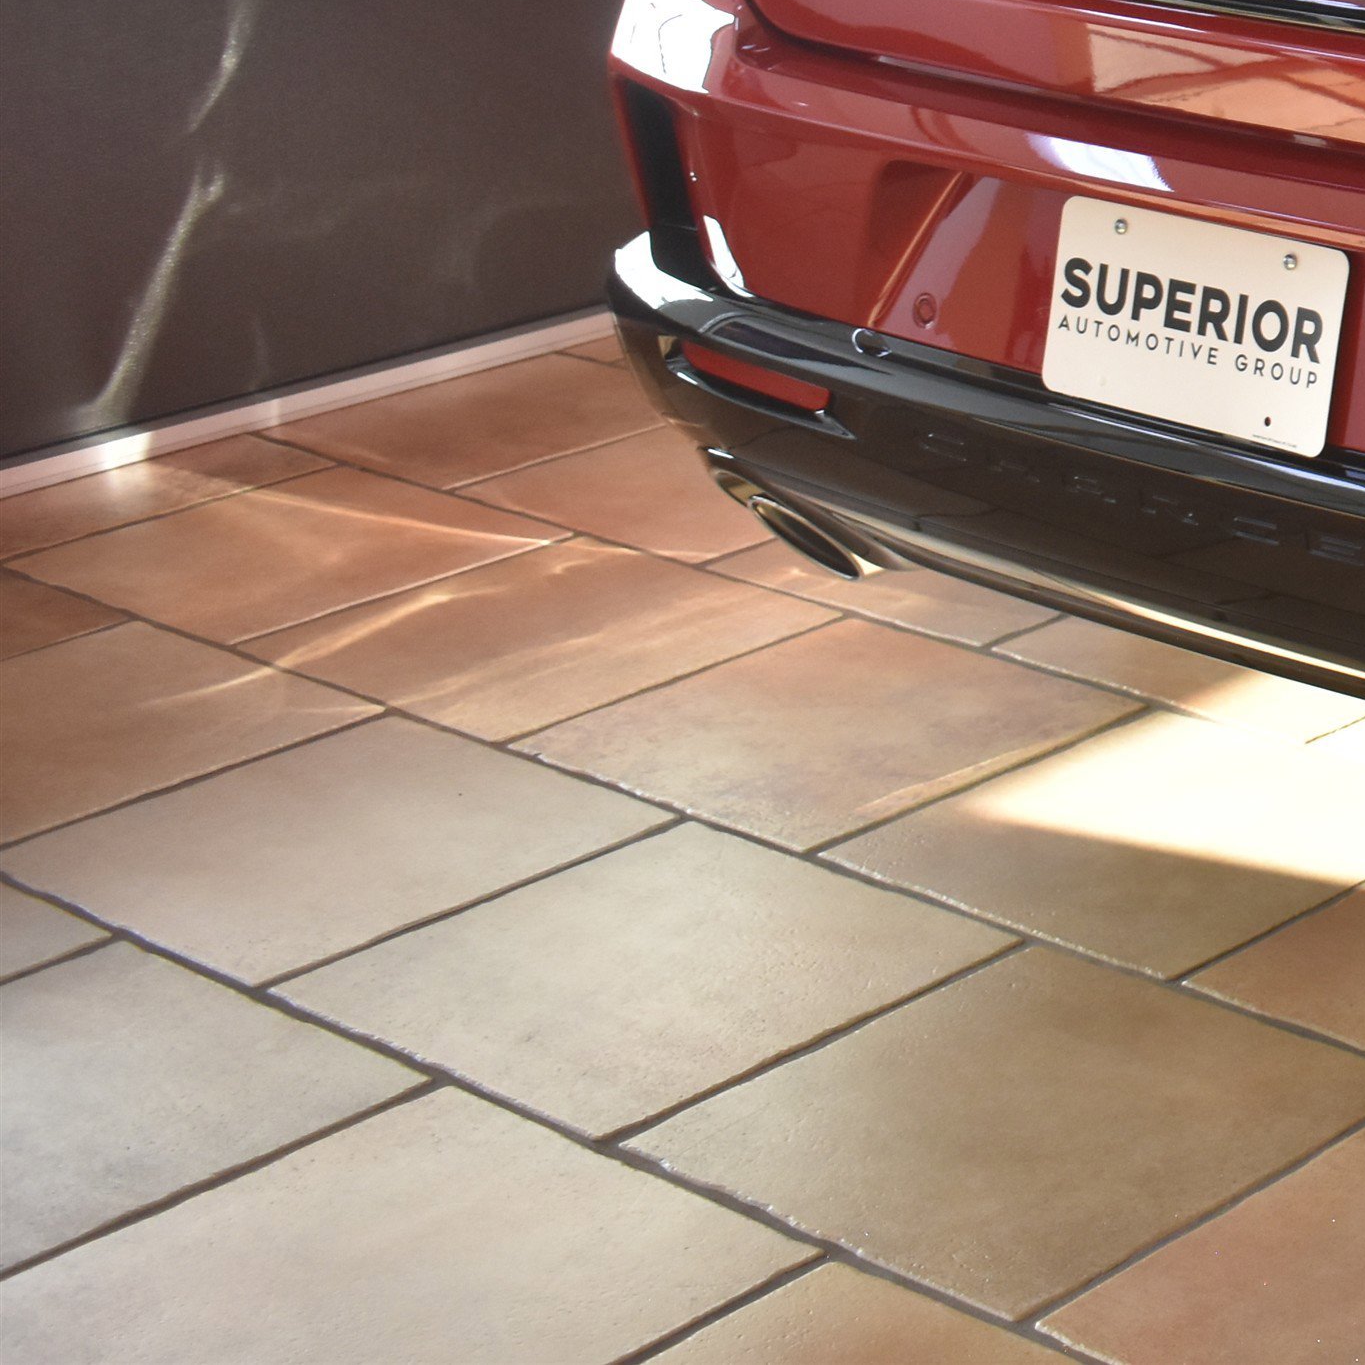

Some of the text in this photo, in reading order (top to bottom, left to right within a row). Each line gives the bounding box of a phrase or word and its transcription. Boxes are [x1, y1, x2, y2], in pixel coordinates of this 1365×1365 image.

[1058, 314, 1318, 389] AUTOMOTIVE GROUP
[1060, 257, 1323, 365] SUPERIOR
